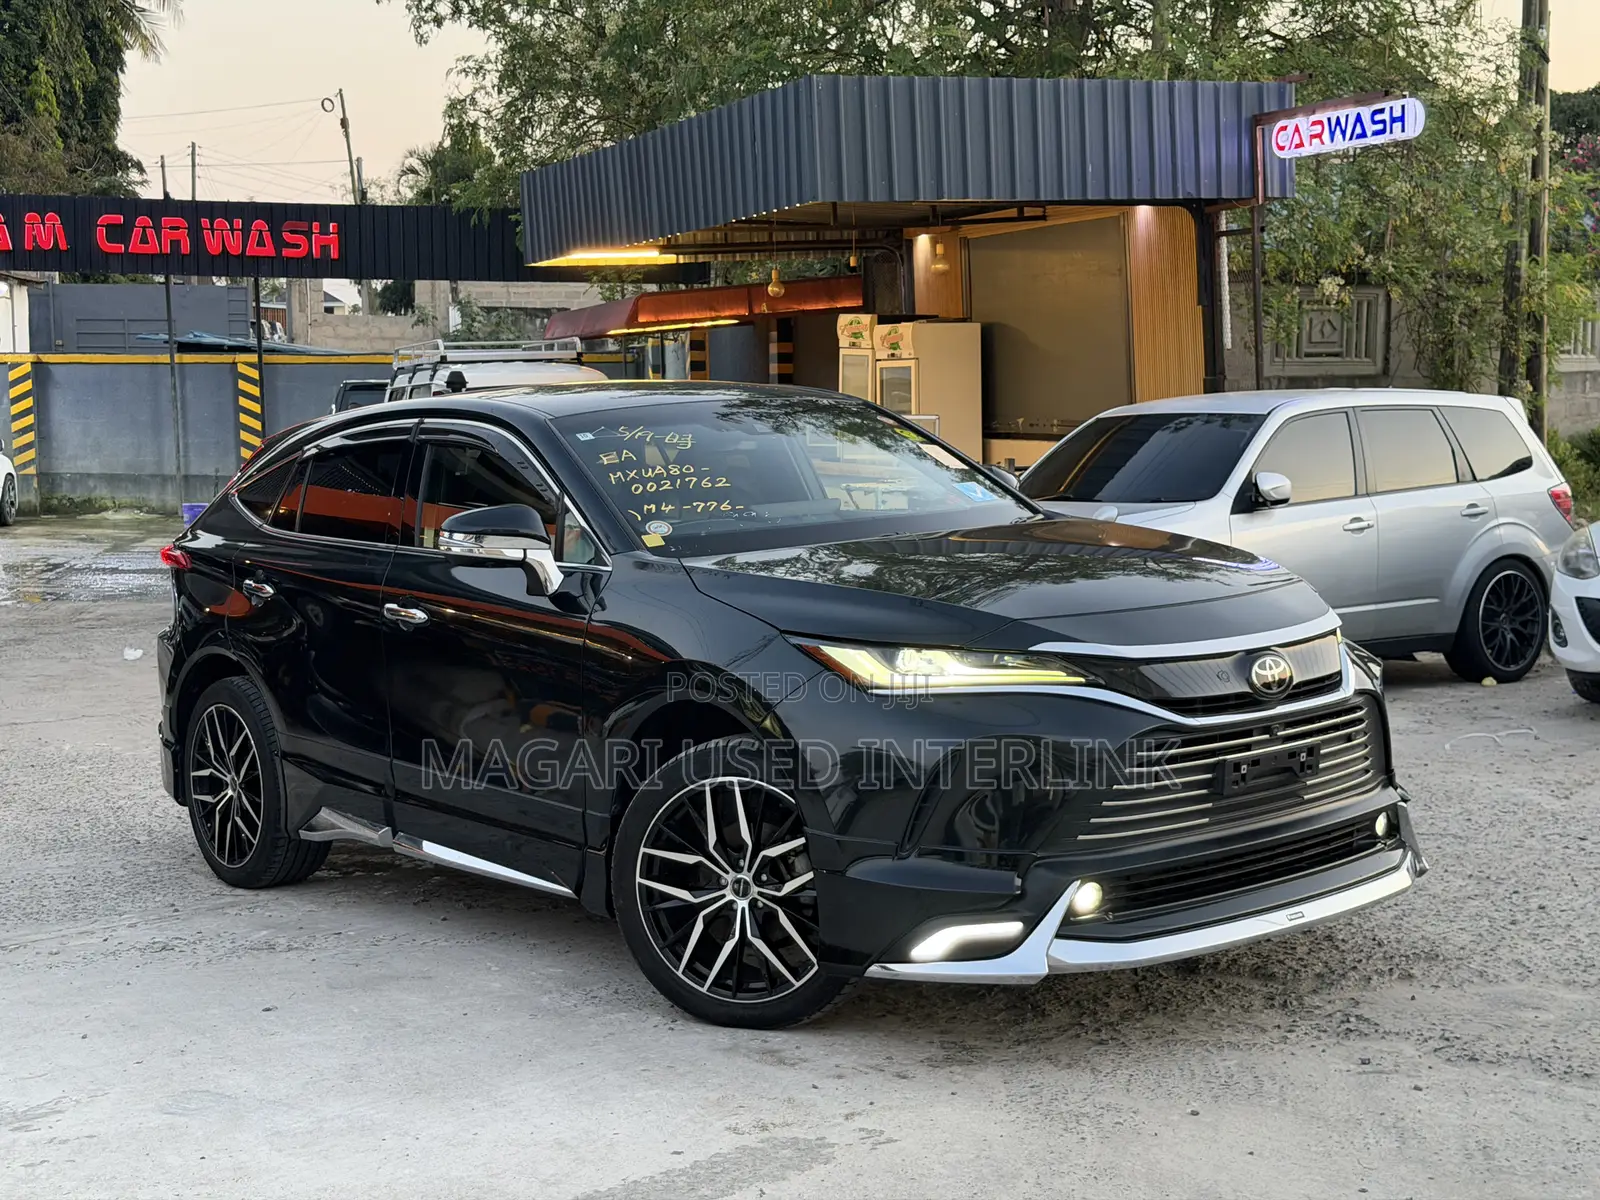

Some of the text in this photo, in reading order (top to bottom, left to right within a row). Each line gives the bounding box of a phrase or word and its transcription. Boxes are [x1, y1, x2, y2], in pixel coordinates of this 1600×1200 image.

[96, 214, 190, 254] CAR
[201, 218, 340, 259] WASH
[631, 477, 731, 495] 0021762
